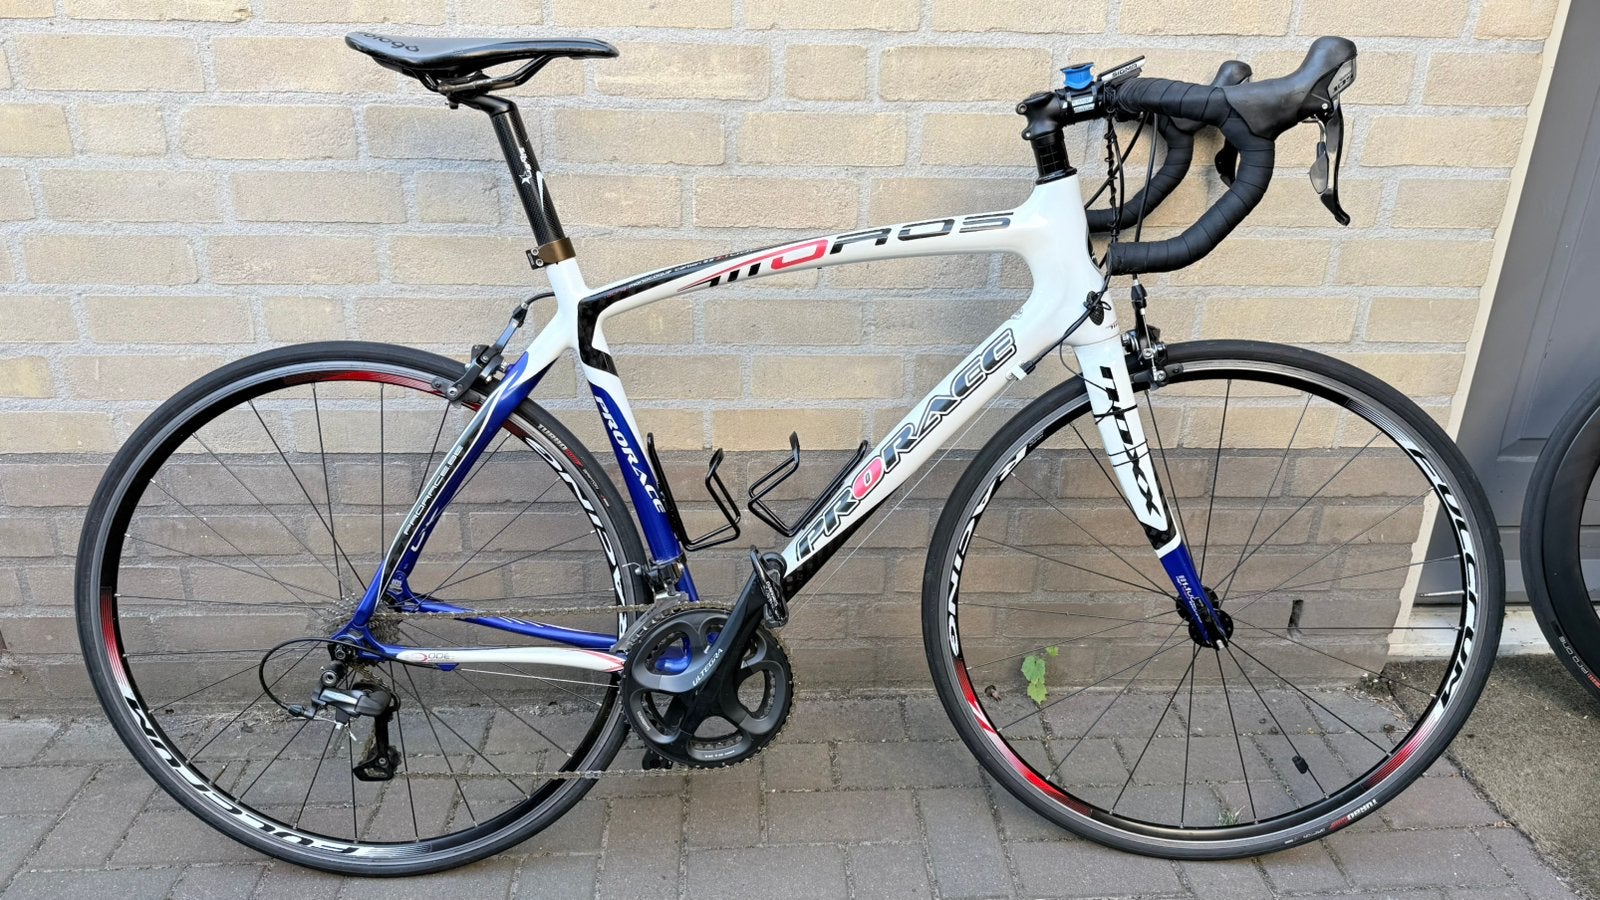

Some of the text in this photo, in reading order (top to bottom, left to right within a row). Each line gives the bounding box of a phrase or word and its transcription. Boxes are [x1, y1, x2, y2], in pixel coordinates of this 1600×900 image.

[594, 395, 666, 514] PRORACE
[796, 328, 1017, 561] PRORACE
[948, 444, 1028, 657] RACING
[1406, 447, 1478, 709] FULCRUM
[692, 648, 724, 686] ULTEGRA
[125, 695, 360, 855] FULCRUM
